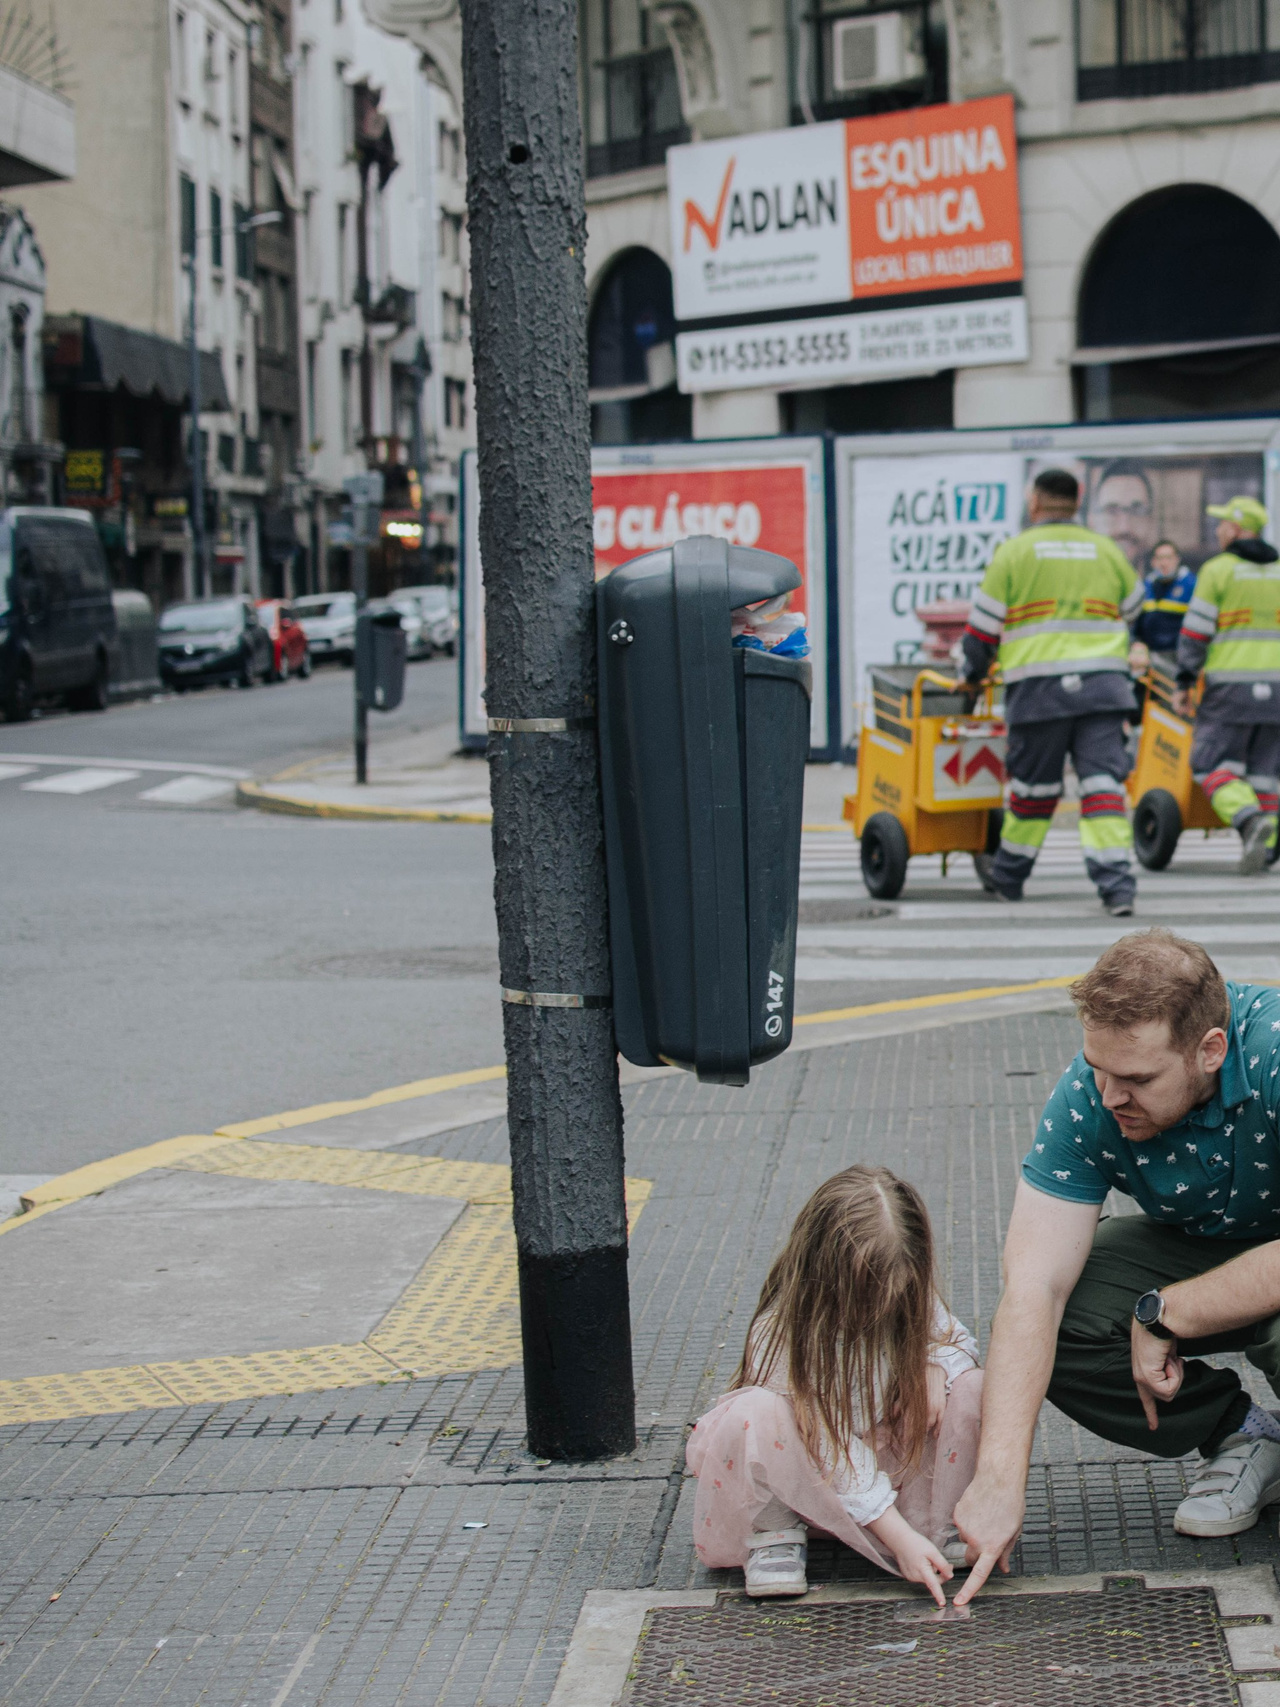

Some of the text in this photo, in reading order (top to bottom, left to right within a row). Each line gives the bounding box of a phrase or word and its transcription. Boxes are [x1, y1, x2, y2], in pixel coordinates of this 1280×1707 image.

[850, 124, 1006, 191] ESQUINA
[683, 155, 839, 253] NADLAN
[875, 184, 985, 243] ÚNICA
[854, 252, 905, 287] LOCAL
[905, 249, 932, 280] EN
[932, 240, 1014, 278] ALQUILER
[709, 331, 851, 374] 11-5352-5555
[618, 490, 761, 551] CLÁSICO
[888, 477, 1006, 527] ACÁ TU
[765, 970, 785, 1012] 147
